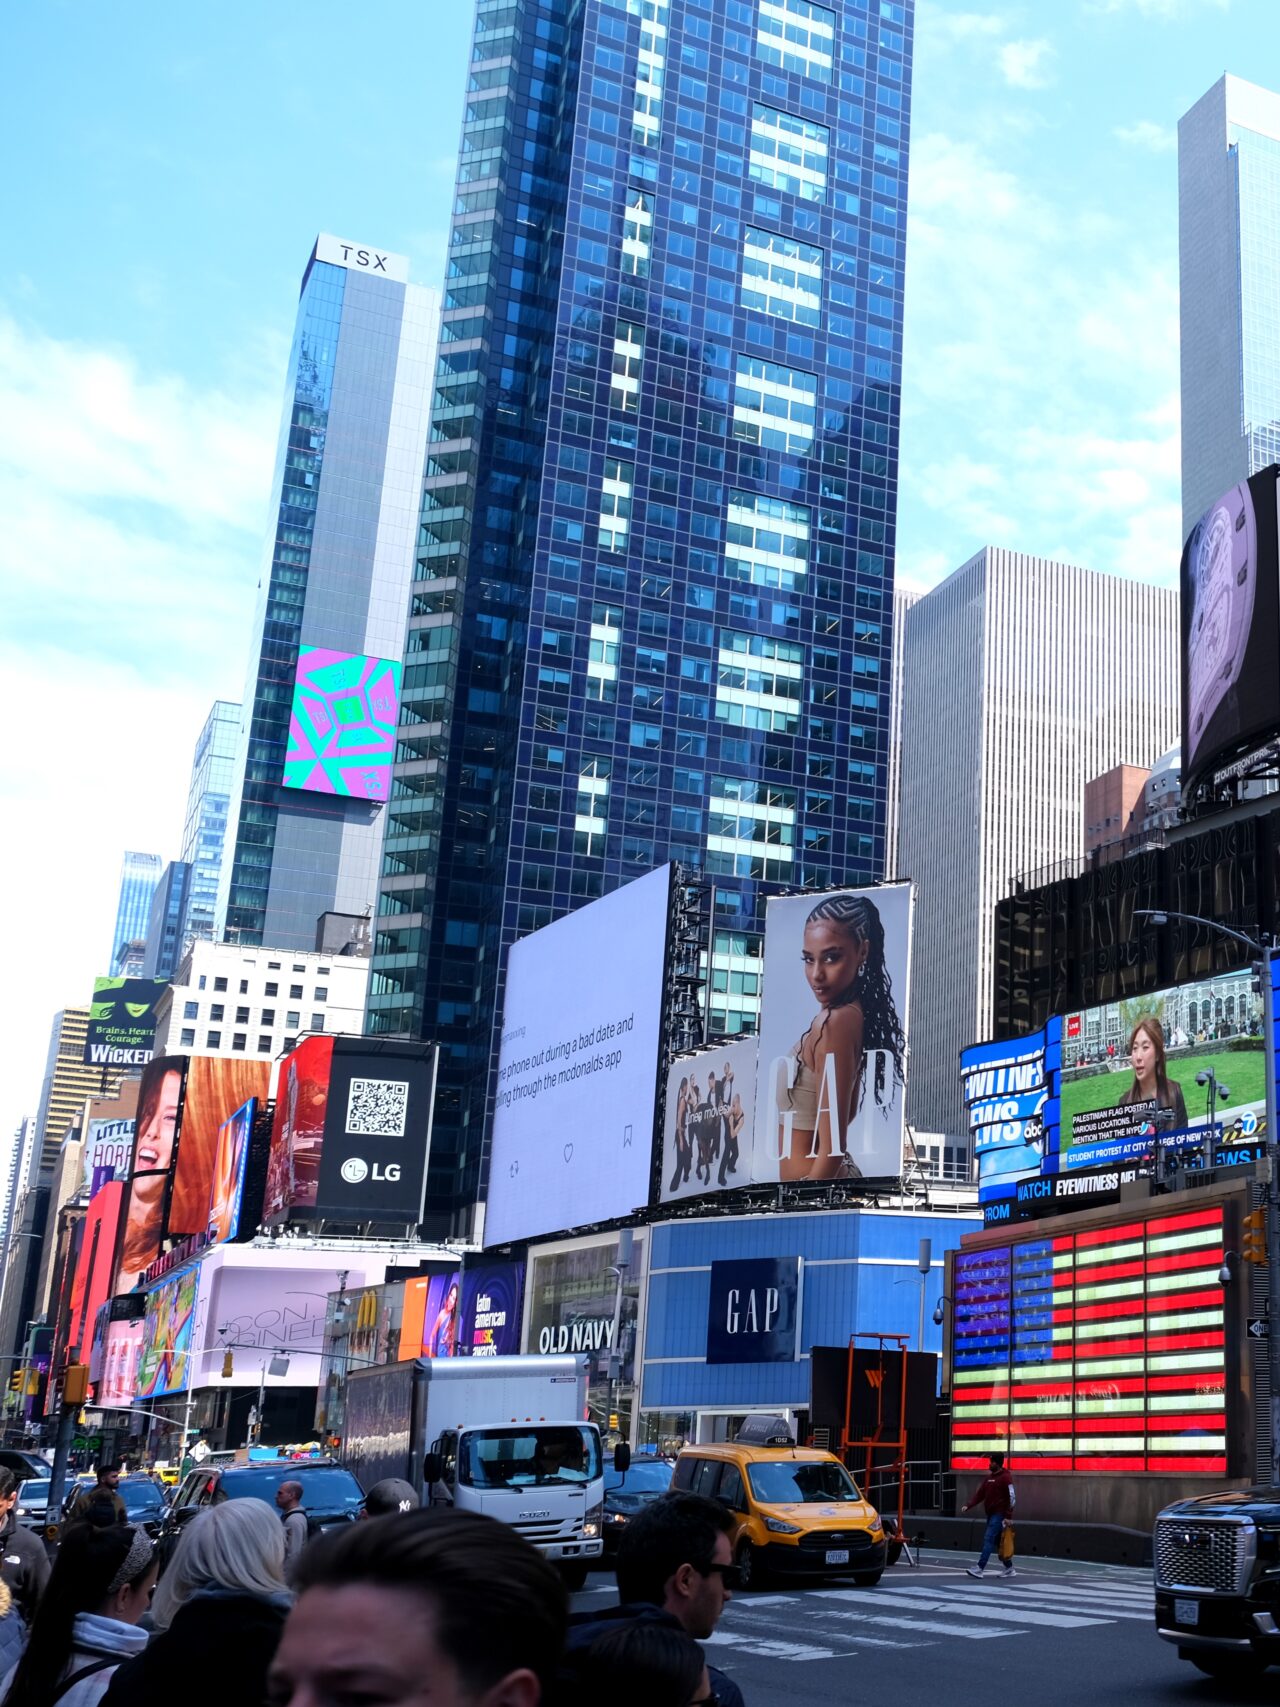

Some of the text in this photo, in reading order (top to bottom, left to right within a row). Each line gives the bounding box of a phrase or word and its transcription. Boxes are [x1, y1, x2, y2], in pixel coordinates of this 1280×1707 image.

[340, 244, 388, 272] TSX
[105, 1034, 145, 1045] Courage.
[507, 1012, 634, 1083] phone out during a bad date and
[513, 1078, 542, 1101] through
[544, 1071, 557, 1090] the
[558, 1053, 604, 1085] mcdonalds
[605, 1049, 622, 1071] app
[766, 1048, 898, 1162] GAP
[1073, 1111, 1108, 1124] PALESTINIAN
[1108, 1108, 1124, 1118] FLAG
[1124, 1104, 1148, 1115] POSTED
[96, 1121, 136, 1142] LITTLE
[1073, 1118, 1131, 1135] VARIOUS LOCATIONS.
[1073, 1134, 1098, 1145] MENTION
[1098, 1131, 1114, 1141] THAT
[1114, 1130, 1125, 1138] THE
[1068, 1150, 1095, 1163] STUDENT
[1096, 1146, 1122, 1158] PROTEST
[1123, 1144, 1131, 1153] AT
[1132, 1142, 1146, 1152] CITY
[1176, 1135, 1185, 1144] OF
[1186, 1133, 1201, 1143] NEW
[372, 1163, 401, 1182] LG
[1017, 1172, 1120, 1202] WATCH EYEWITNESS
[985, 1204, 1010, 1222] FROM
[476, 1293, 491, 1312] latin
[726, 1287, 779, 1334] GAP
[475, 1312, 506, 1328] american
[1254, 1324, 1268, 1333] ONE
[539, 1326, 568, 1355] OLD
[571, 1319, 614, 1351] NAVY
[519, 1511, 550, 1519] ISUZU
